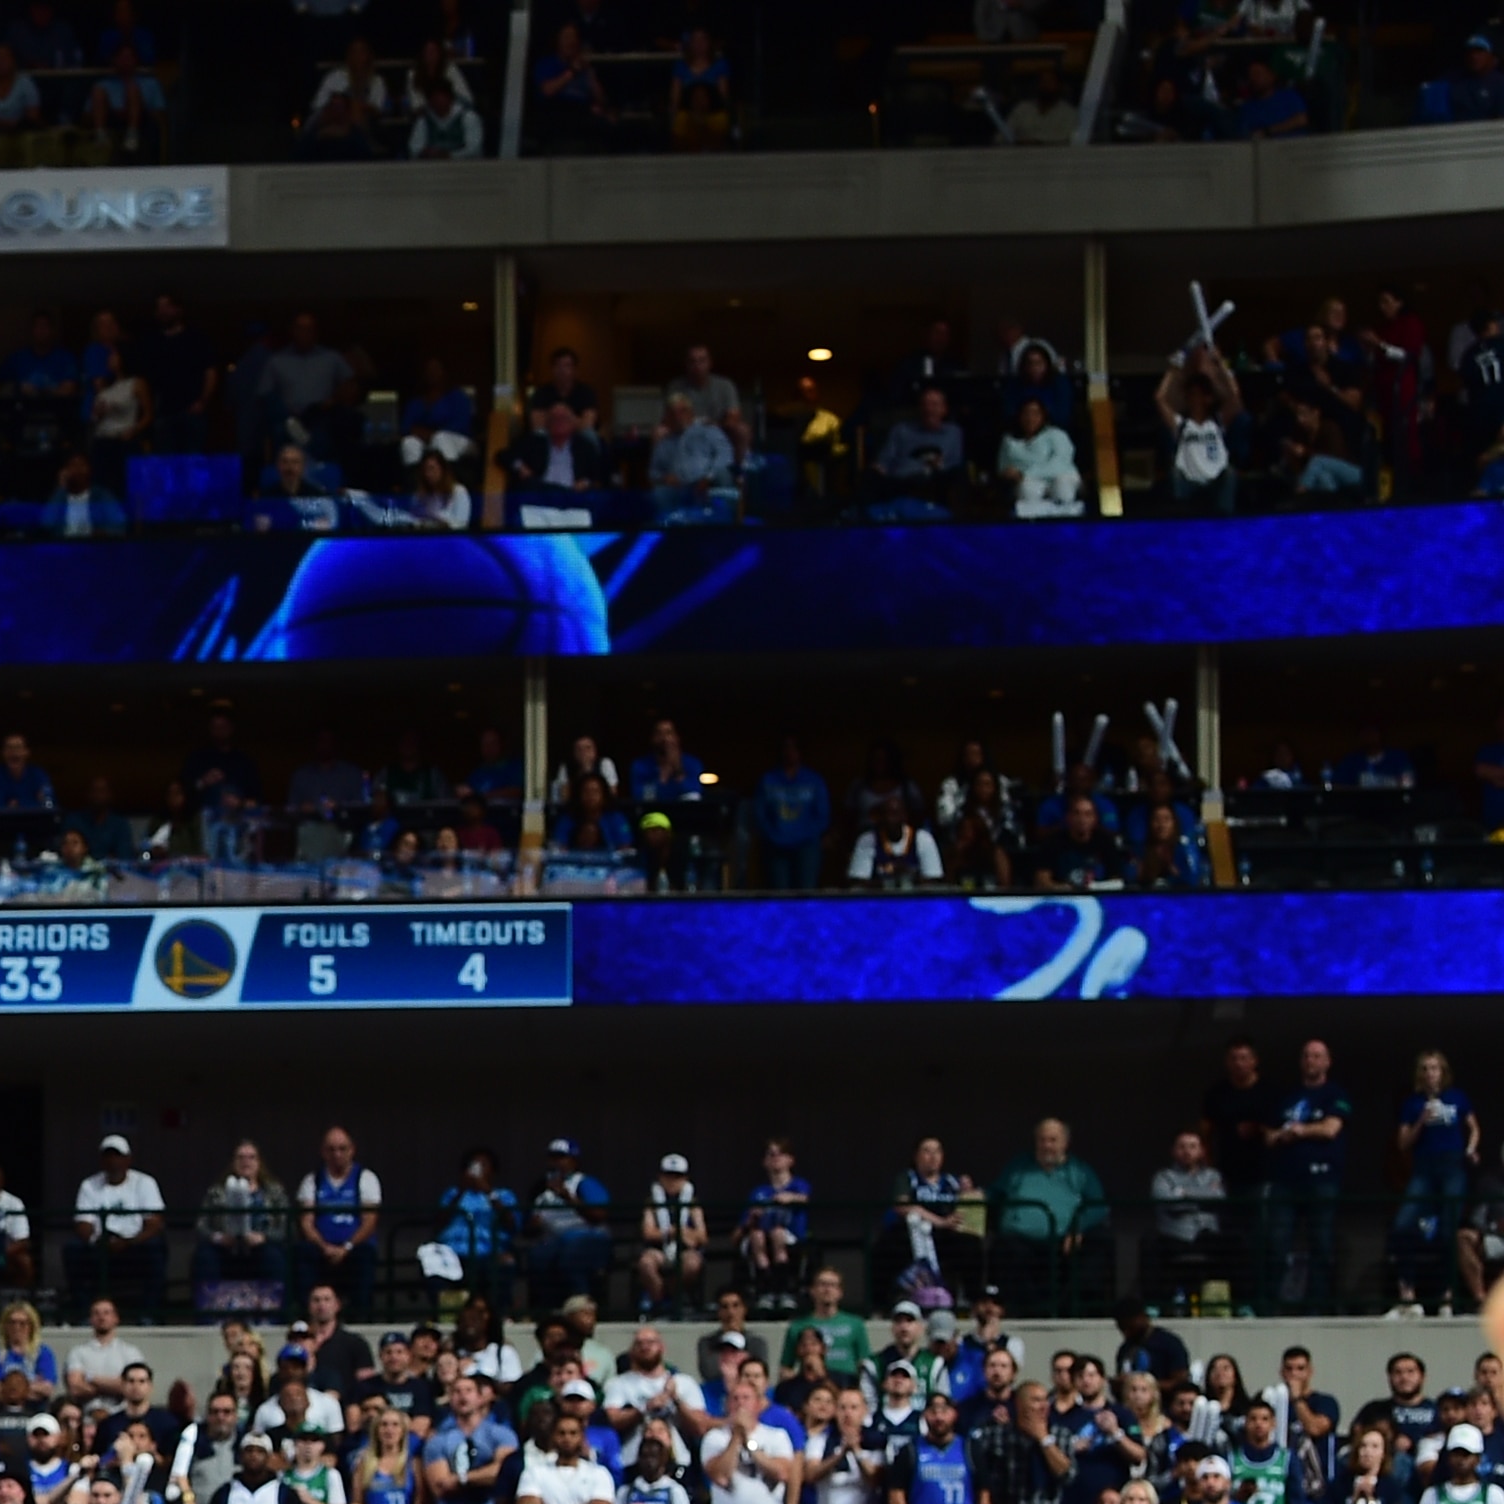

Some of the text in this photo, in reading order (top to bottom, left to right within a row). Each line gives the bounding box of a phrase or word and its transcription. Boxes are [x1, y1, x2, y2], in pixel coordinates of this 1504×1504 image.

[282, 922, 371, 948] FOULS
[409, 919, 546, 946] TIMEOUTS
[309, 954, 338, 995] 5
[457, 952, 488, 992] 4
